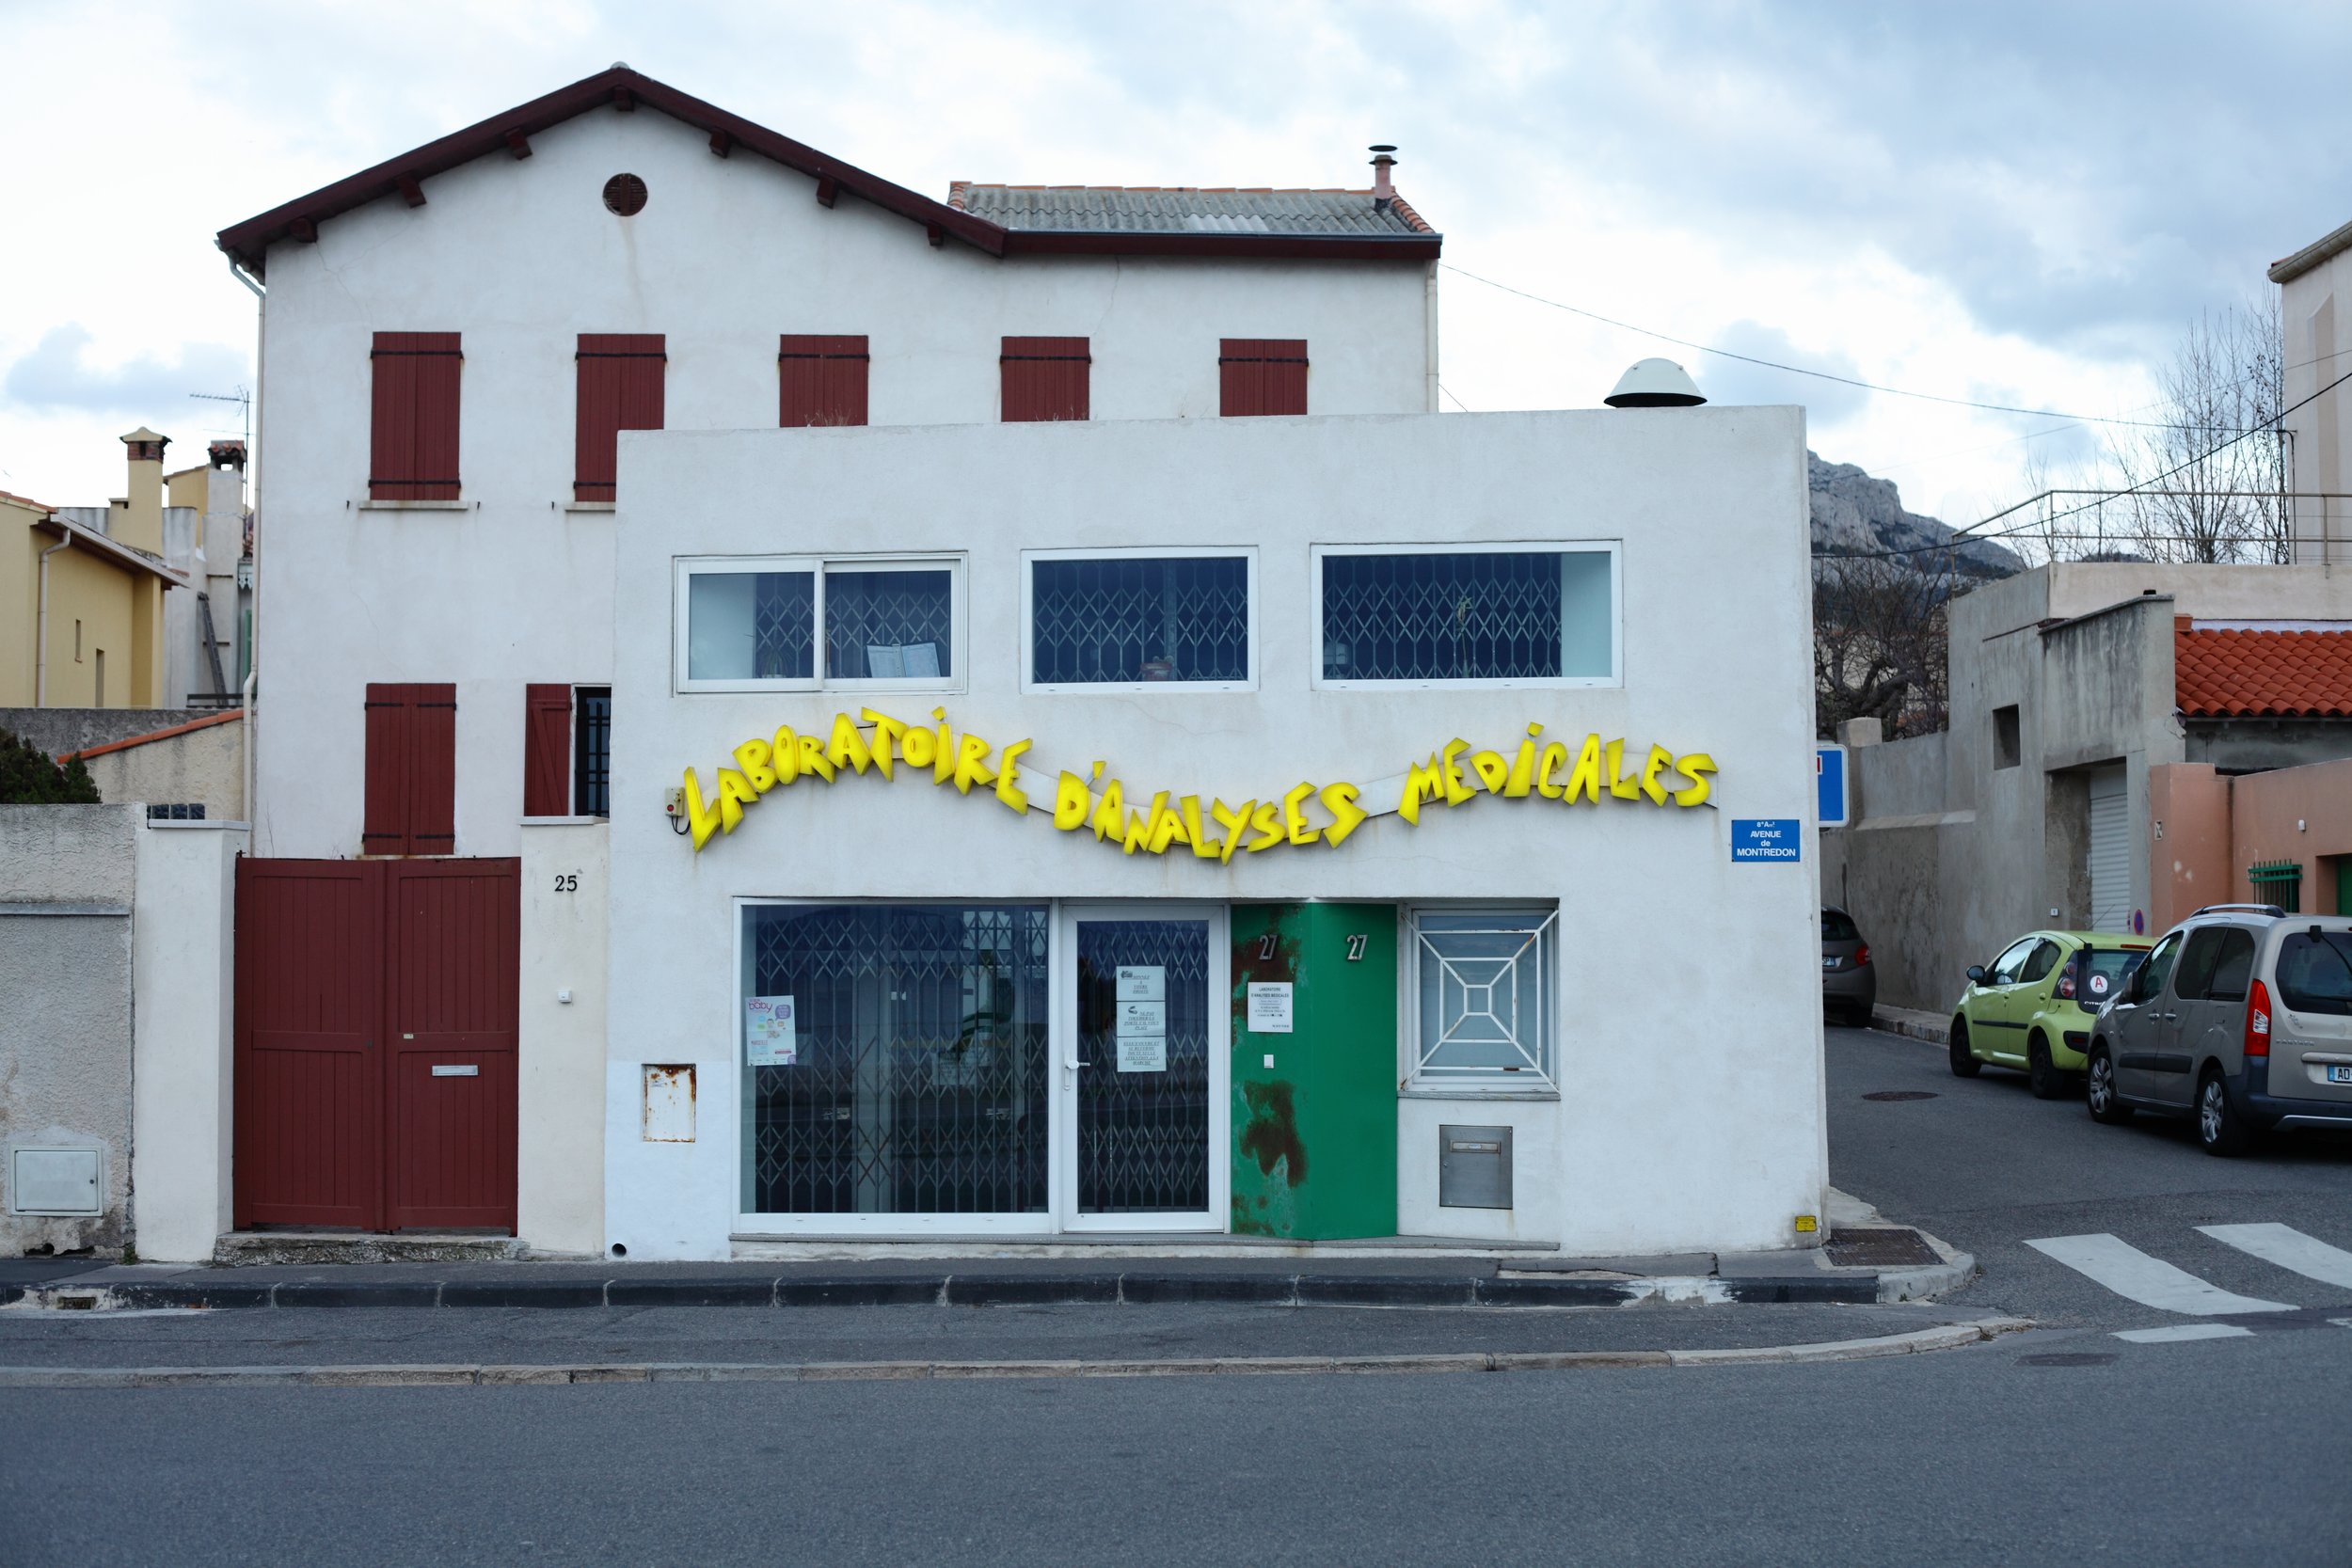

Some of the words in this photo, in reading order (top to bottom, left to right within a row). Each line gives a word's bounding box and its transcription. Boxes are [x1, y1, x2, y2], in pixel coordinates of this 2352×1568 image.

[1054, 761, 1368, 865] D'ANALYSES
[1750, 830, 1781, 838] AVENUE
[1737, 847, 1796, 857] MONTREDON
[554, 875, 578, 892] 25
[1259, 934, 1278, 960] 27
[1346, 934, 1368, 960] 27
[2095, 976, 2104, 988] A
[749, 1001, 772, 1013] baby
